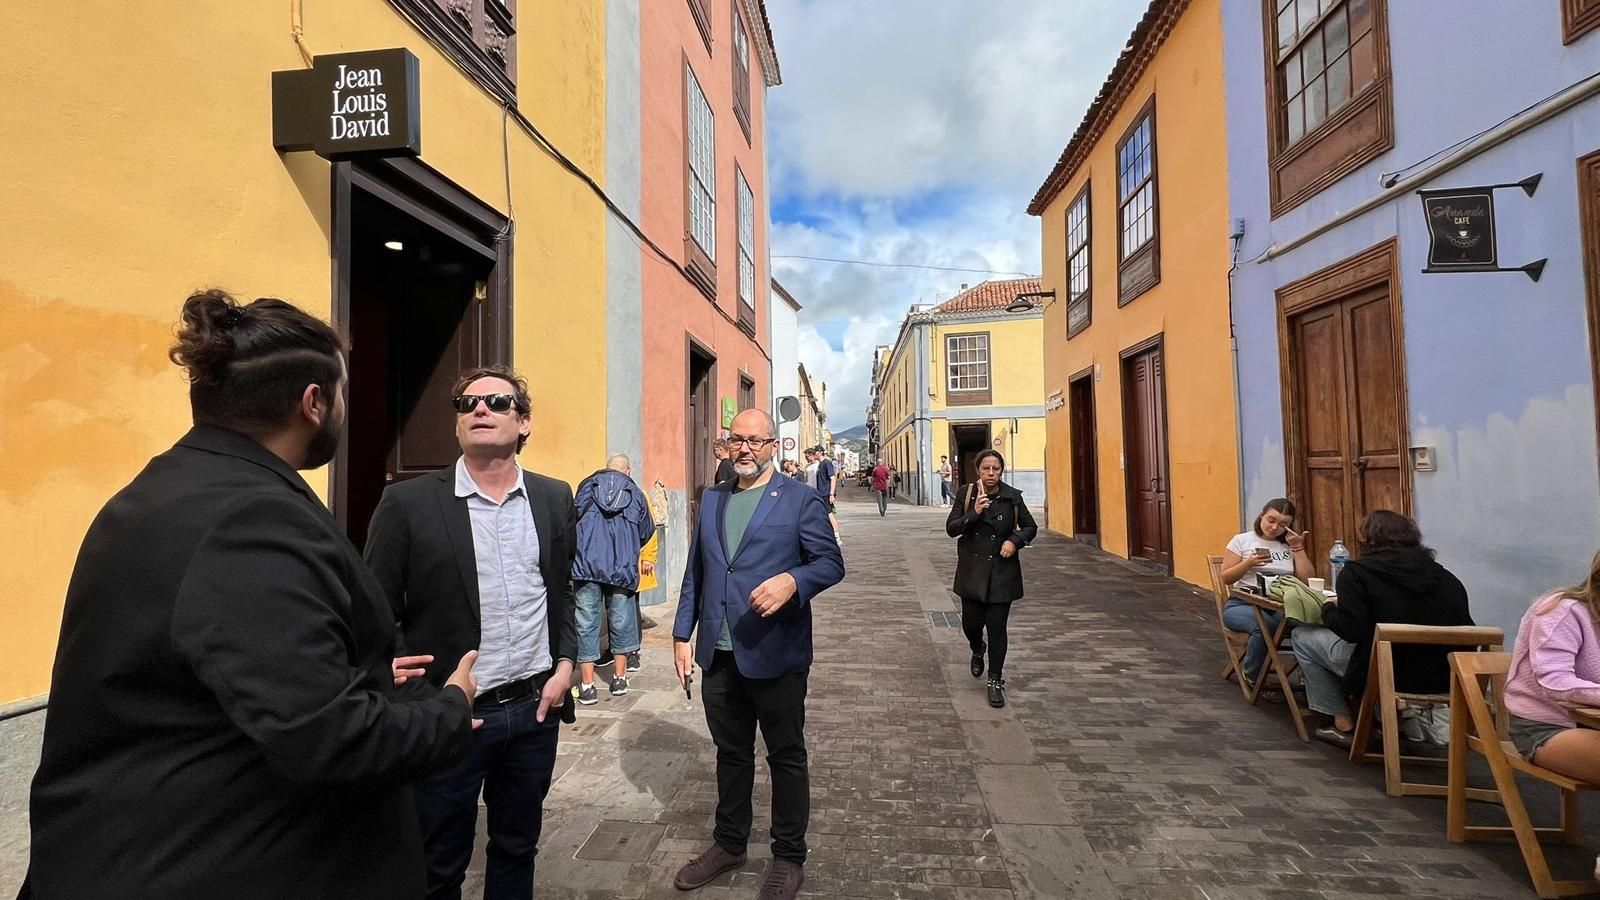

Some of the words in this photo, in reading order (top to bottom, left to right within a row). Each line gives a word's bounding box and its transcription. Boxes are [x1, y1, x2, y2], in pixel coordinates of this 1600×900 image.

[335, 65, 382, 89] Jean
[332, 88, 386, 115] Louis
[330, 111, 390, 140] David
